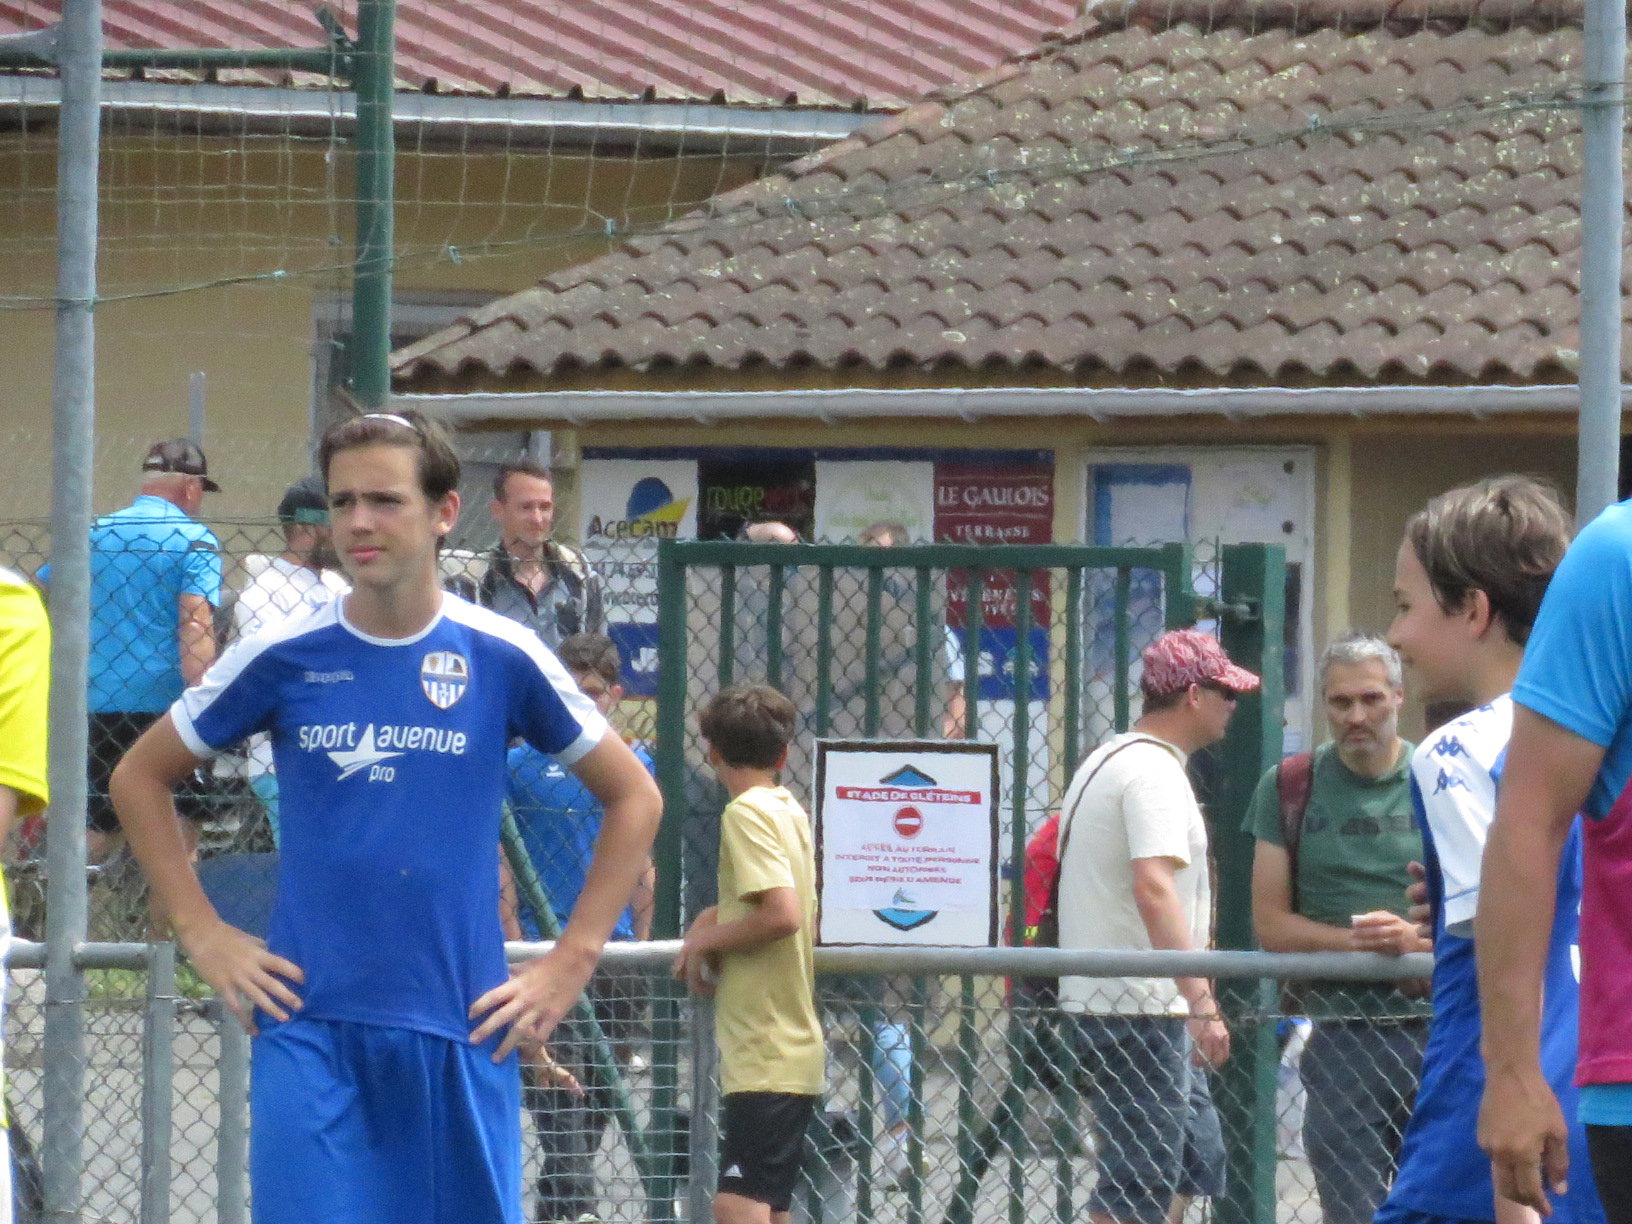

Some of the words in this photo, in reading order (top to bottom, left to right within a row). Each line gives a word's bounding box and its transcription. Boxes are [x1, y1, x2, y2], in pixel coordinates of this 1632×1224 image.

[938, 485, 959, 506] LE
[963, 484, 1050, 508] GAULOIS
[587, 514, 679, 539] Acecam
[299, 721, 357, 753] sport
[377, 725, 467, 756] avenue
[367, 764, 395, 783] pro
[846, 789, 889, 801] STADE
[890, 790, 908, 801] DE
